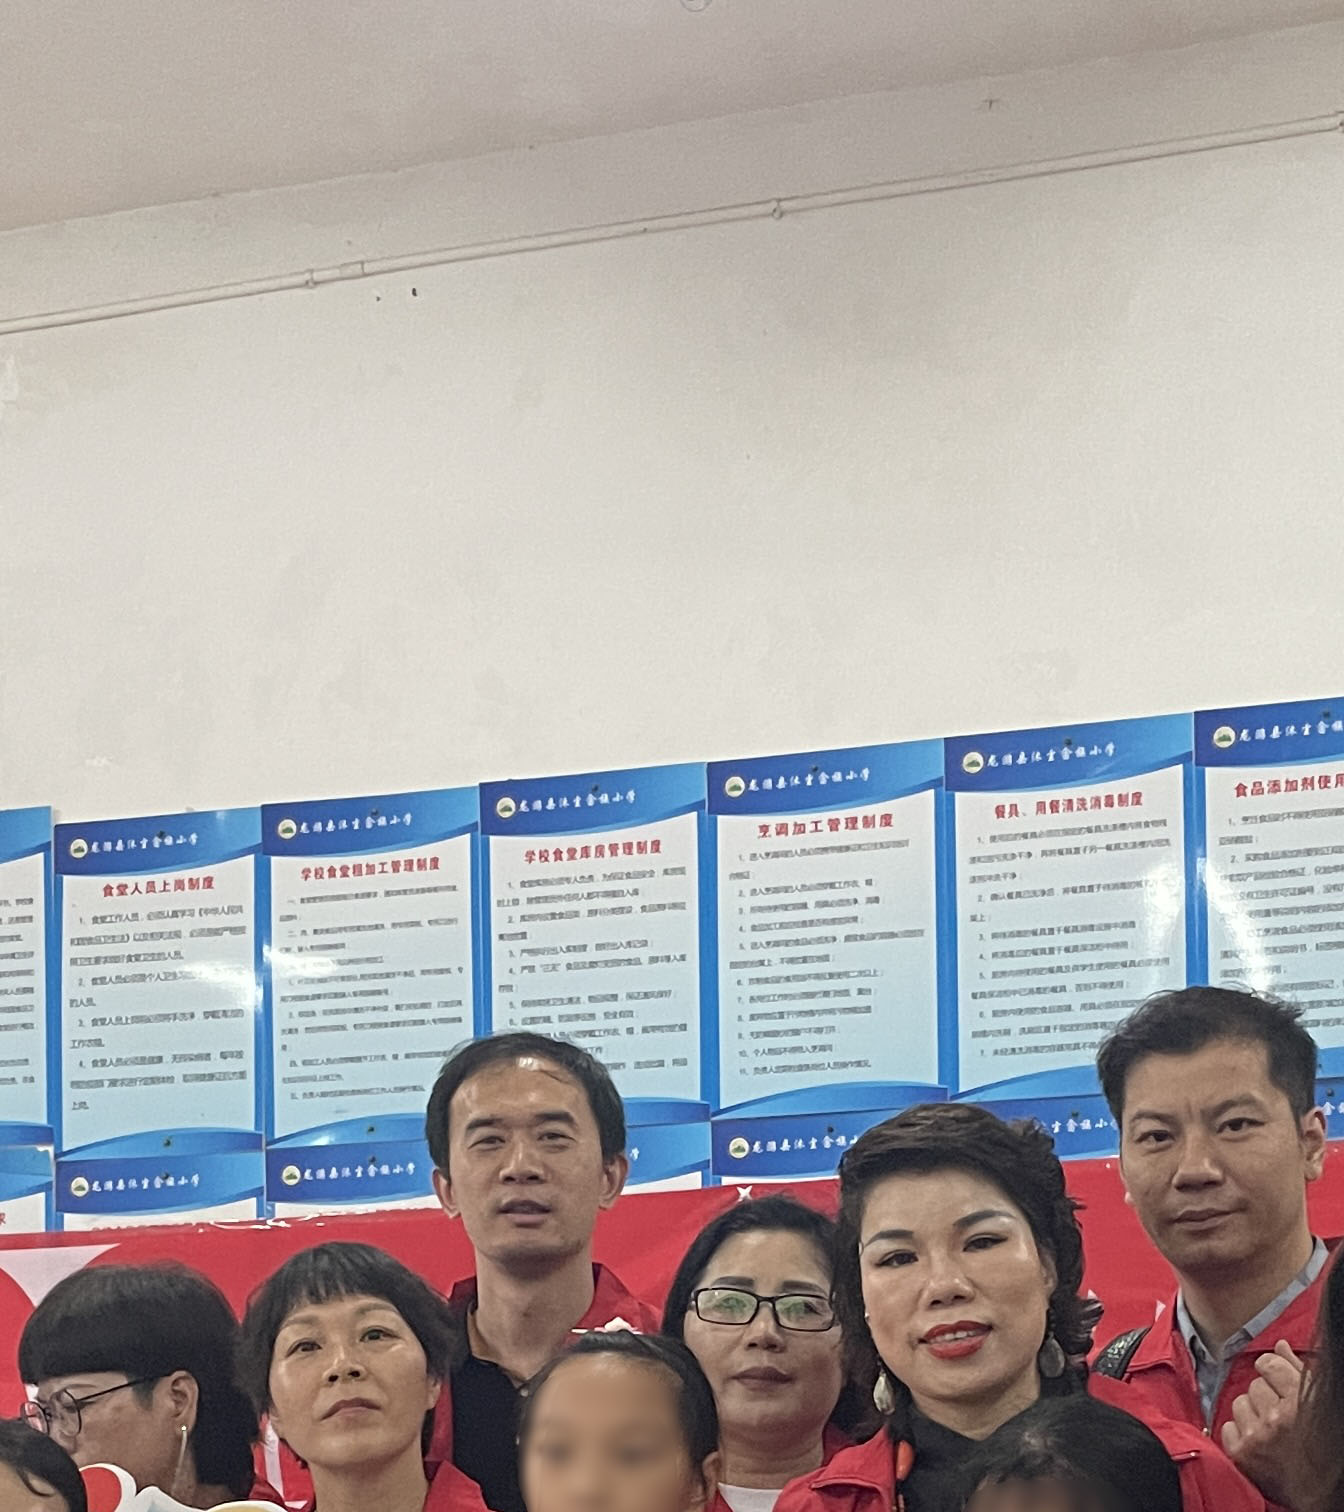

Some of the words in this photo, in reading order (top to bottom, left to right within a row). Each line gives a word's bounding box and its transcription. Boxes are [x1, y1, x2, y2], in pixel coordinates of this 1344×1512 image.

[757, 813, 894, 839] 烹调加工管理制度
[524, 839, 662, 865] 学校食堂库房管理制度
[102, 876, 215, 898] 食堂人员上岗制度
